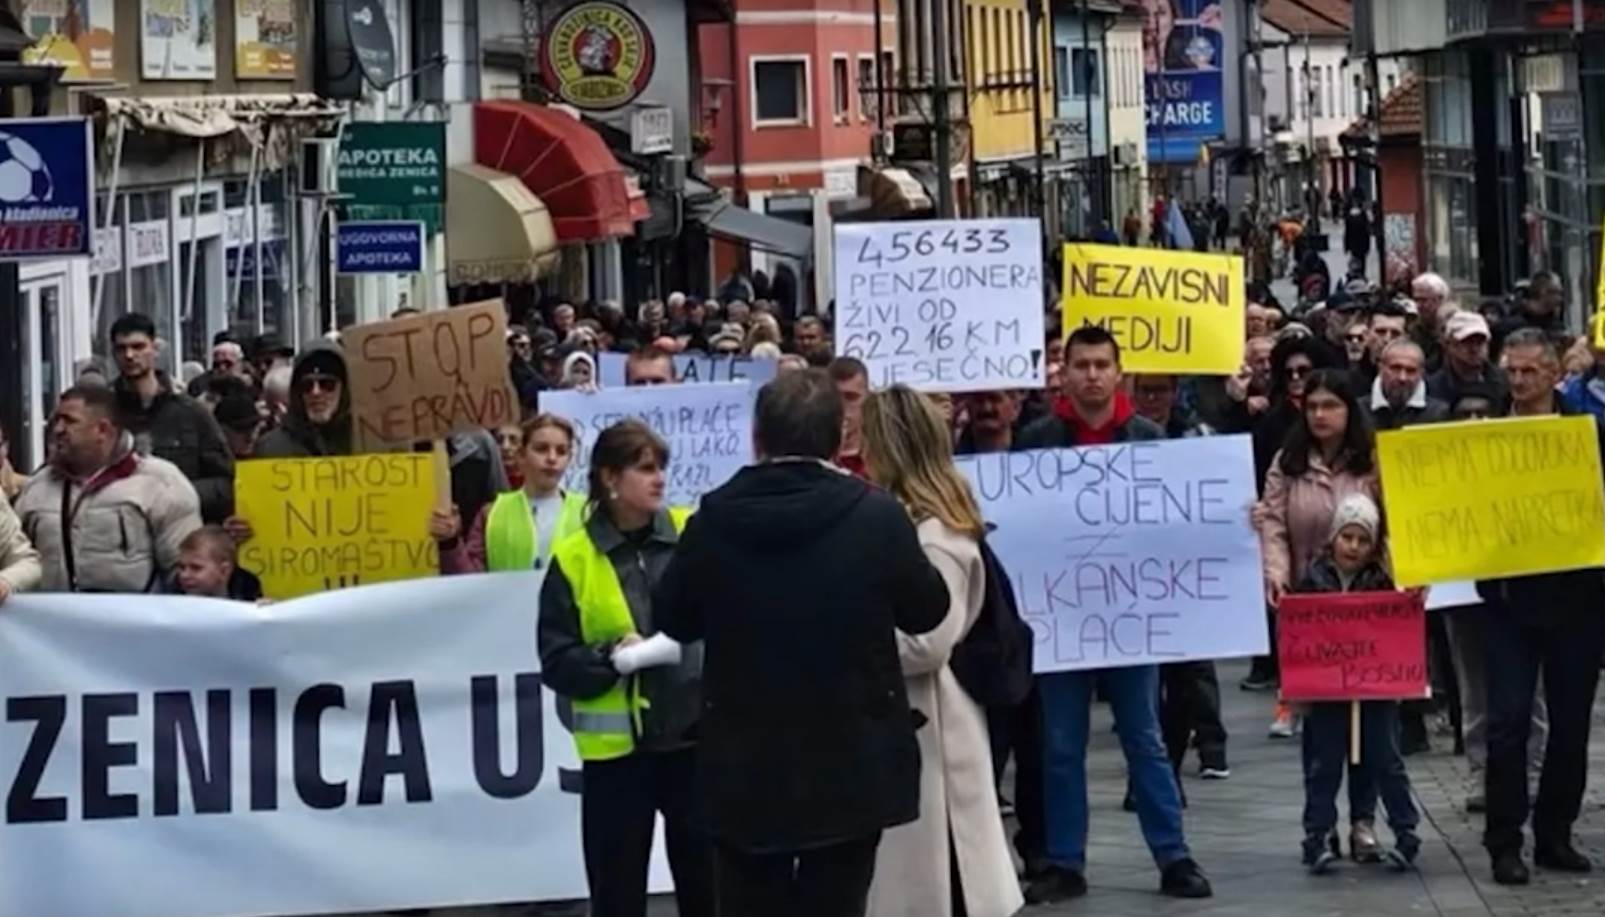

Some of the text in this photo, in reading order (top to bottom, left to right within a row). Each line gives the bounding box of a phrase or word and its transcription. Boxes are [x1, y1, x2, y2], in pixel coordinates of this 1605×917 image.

[338, 148, 438, 165] APOTEKA
[389, 166, 438, 178] ZENICA
[339, 231, 418, 246] UGOVORNA
[346, 251, 412, 265] APOTEKA
[857, 228, 1011, 269] 456433
[849, 263, 1040, 297] PENZIONERA
[1070, 262, 1230, 307] NEZAVISNI
[844, 297, 957, 328] ŽIVI OD
[361, 311, 496, 394] STOP
[271, 454, 428, 492] STAROST
[954, 442, 1163, 501] UROPSKE
[1395, 436, 1479, 491] NEMA
[285, 492, 388, 539] NIJE
[1405, 504, 1487, 563] NEMA
[1017, 557, 1230, 616] LKANSKE
[1034, 601, 1186, 664] PLAĆE
[4, 679, 433, 825] ZENICA
